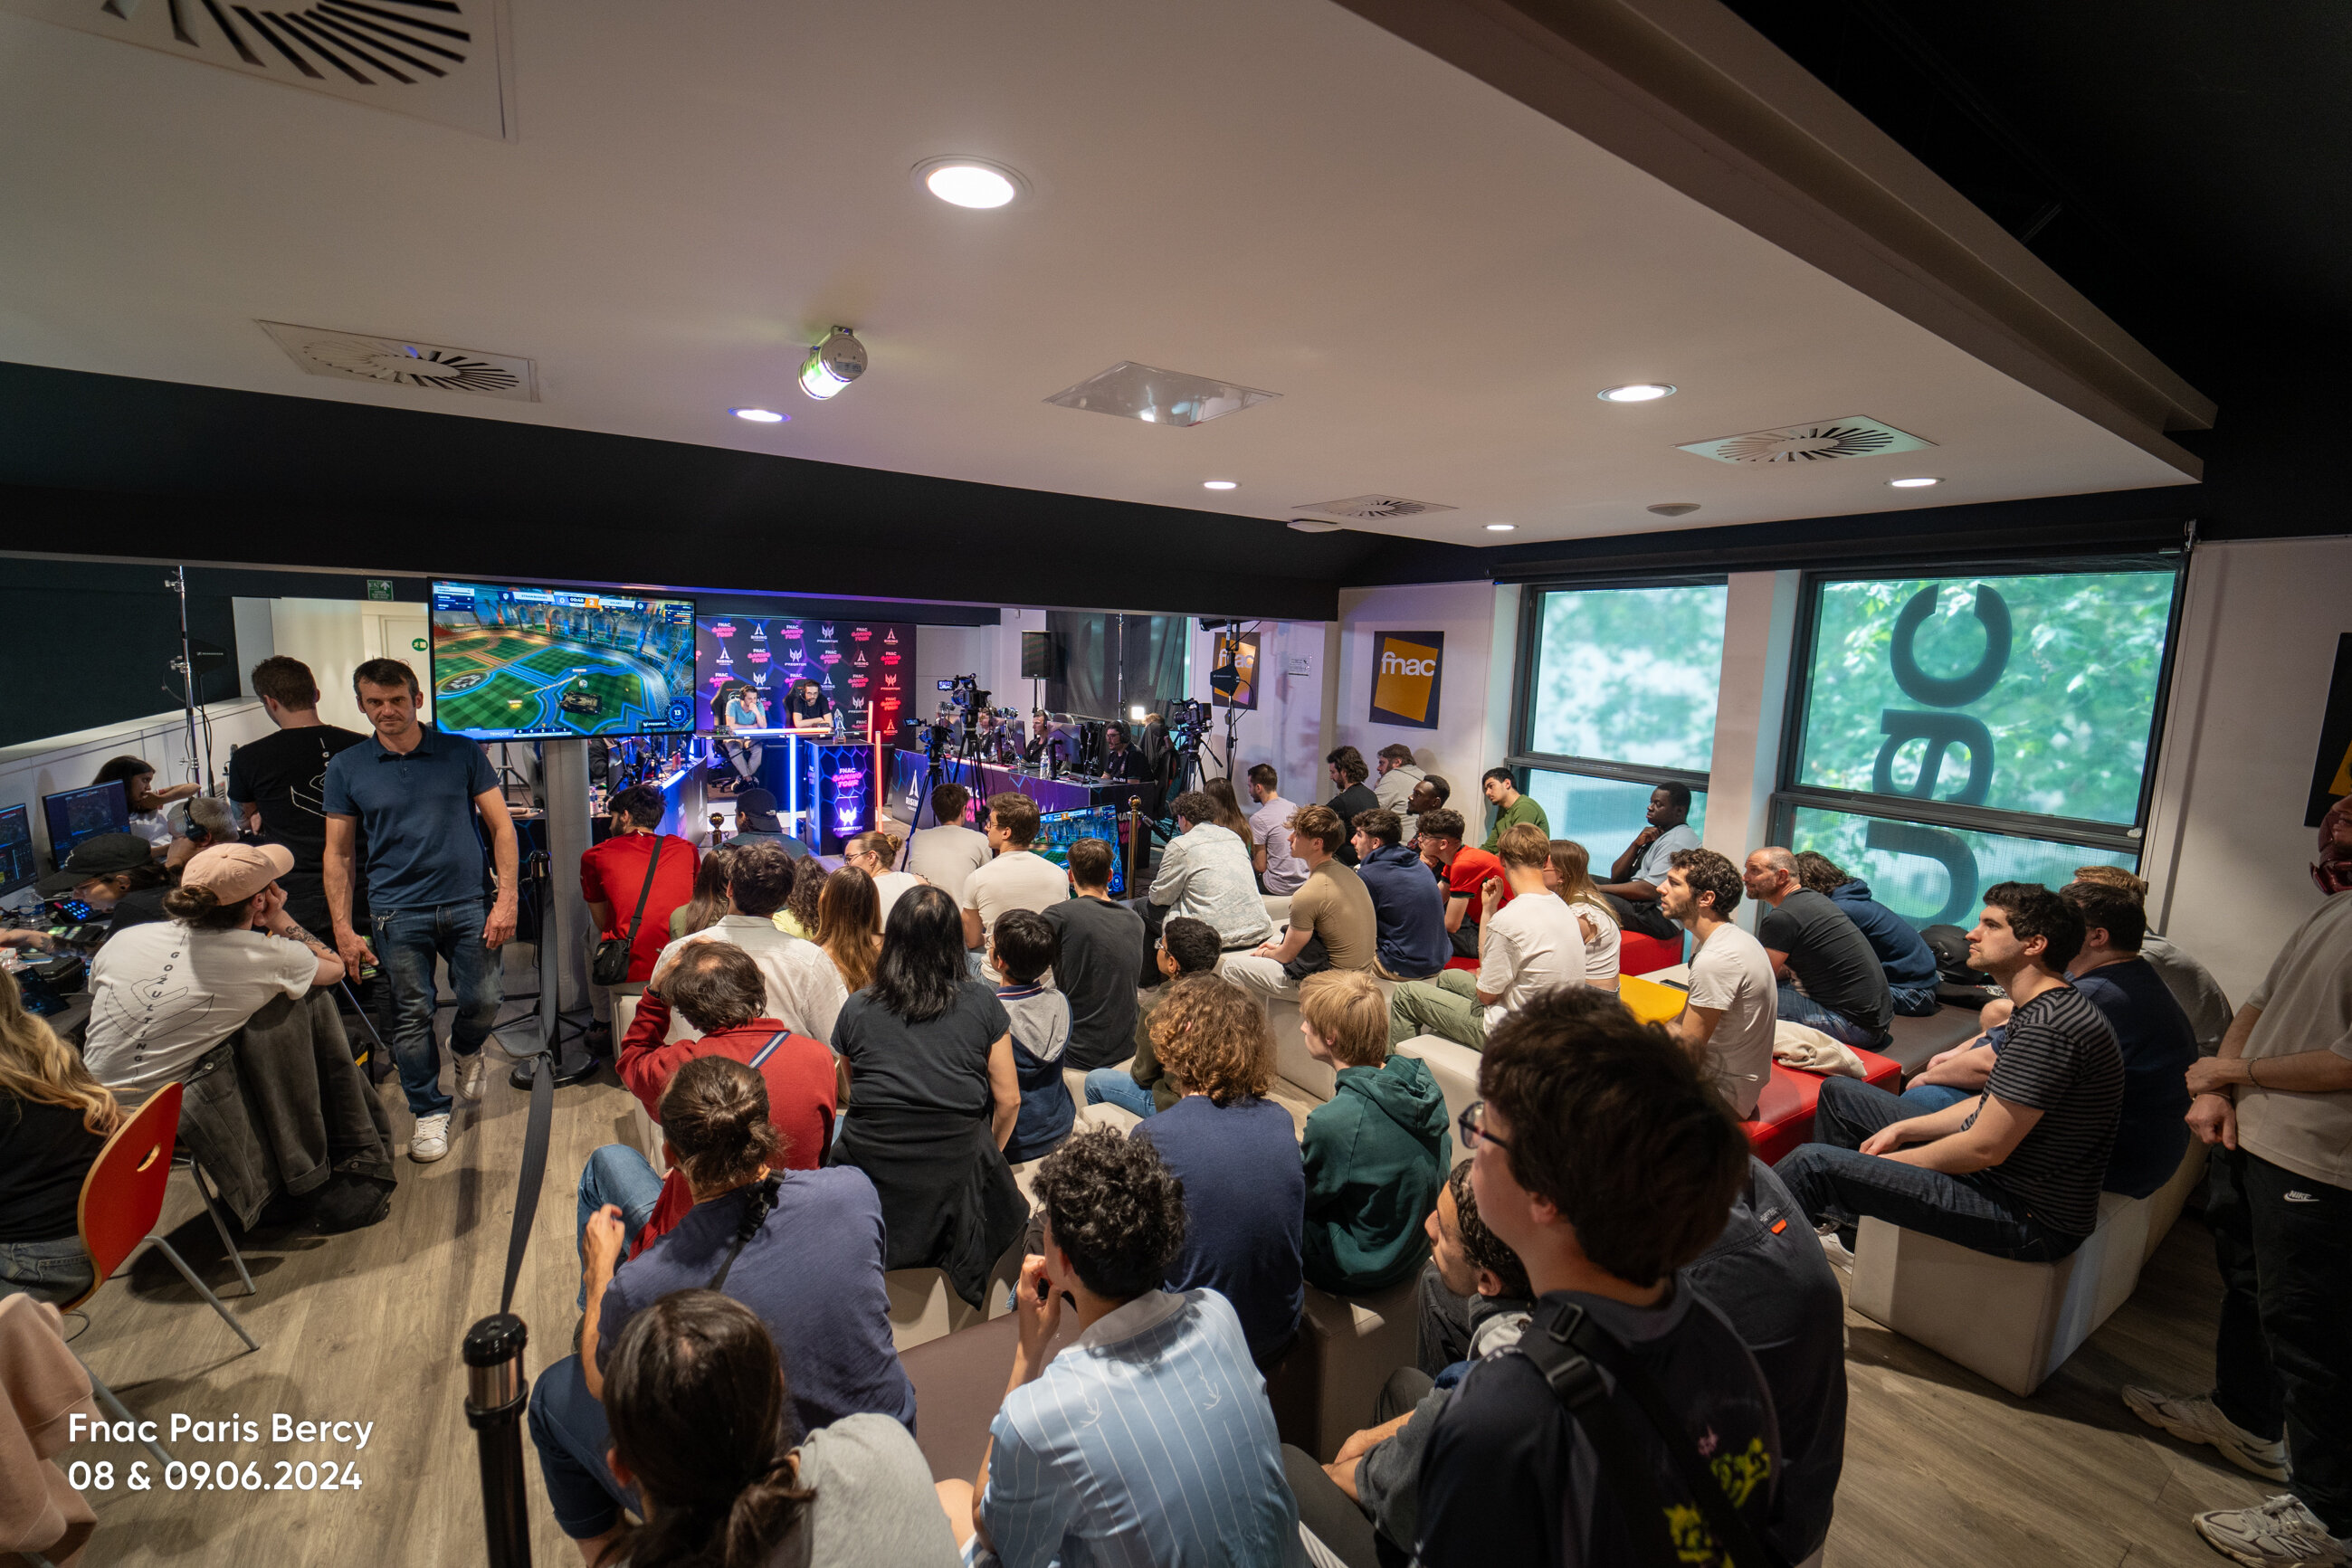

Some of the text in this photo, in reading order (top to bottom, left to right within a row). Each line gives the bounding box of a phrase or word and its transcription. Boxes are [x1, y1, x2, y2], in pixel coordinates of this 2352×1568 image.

[1219, 648, 1254, 668] fac
[1381, 651, 1436, 677] fnac
[832, 772, 862, 782] GAMING
[837, 779, 859, 788] TOUR
